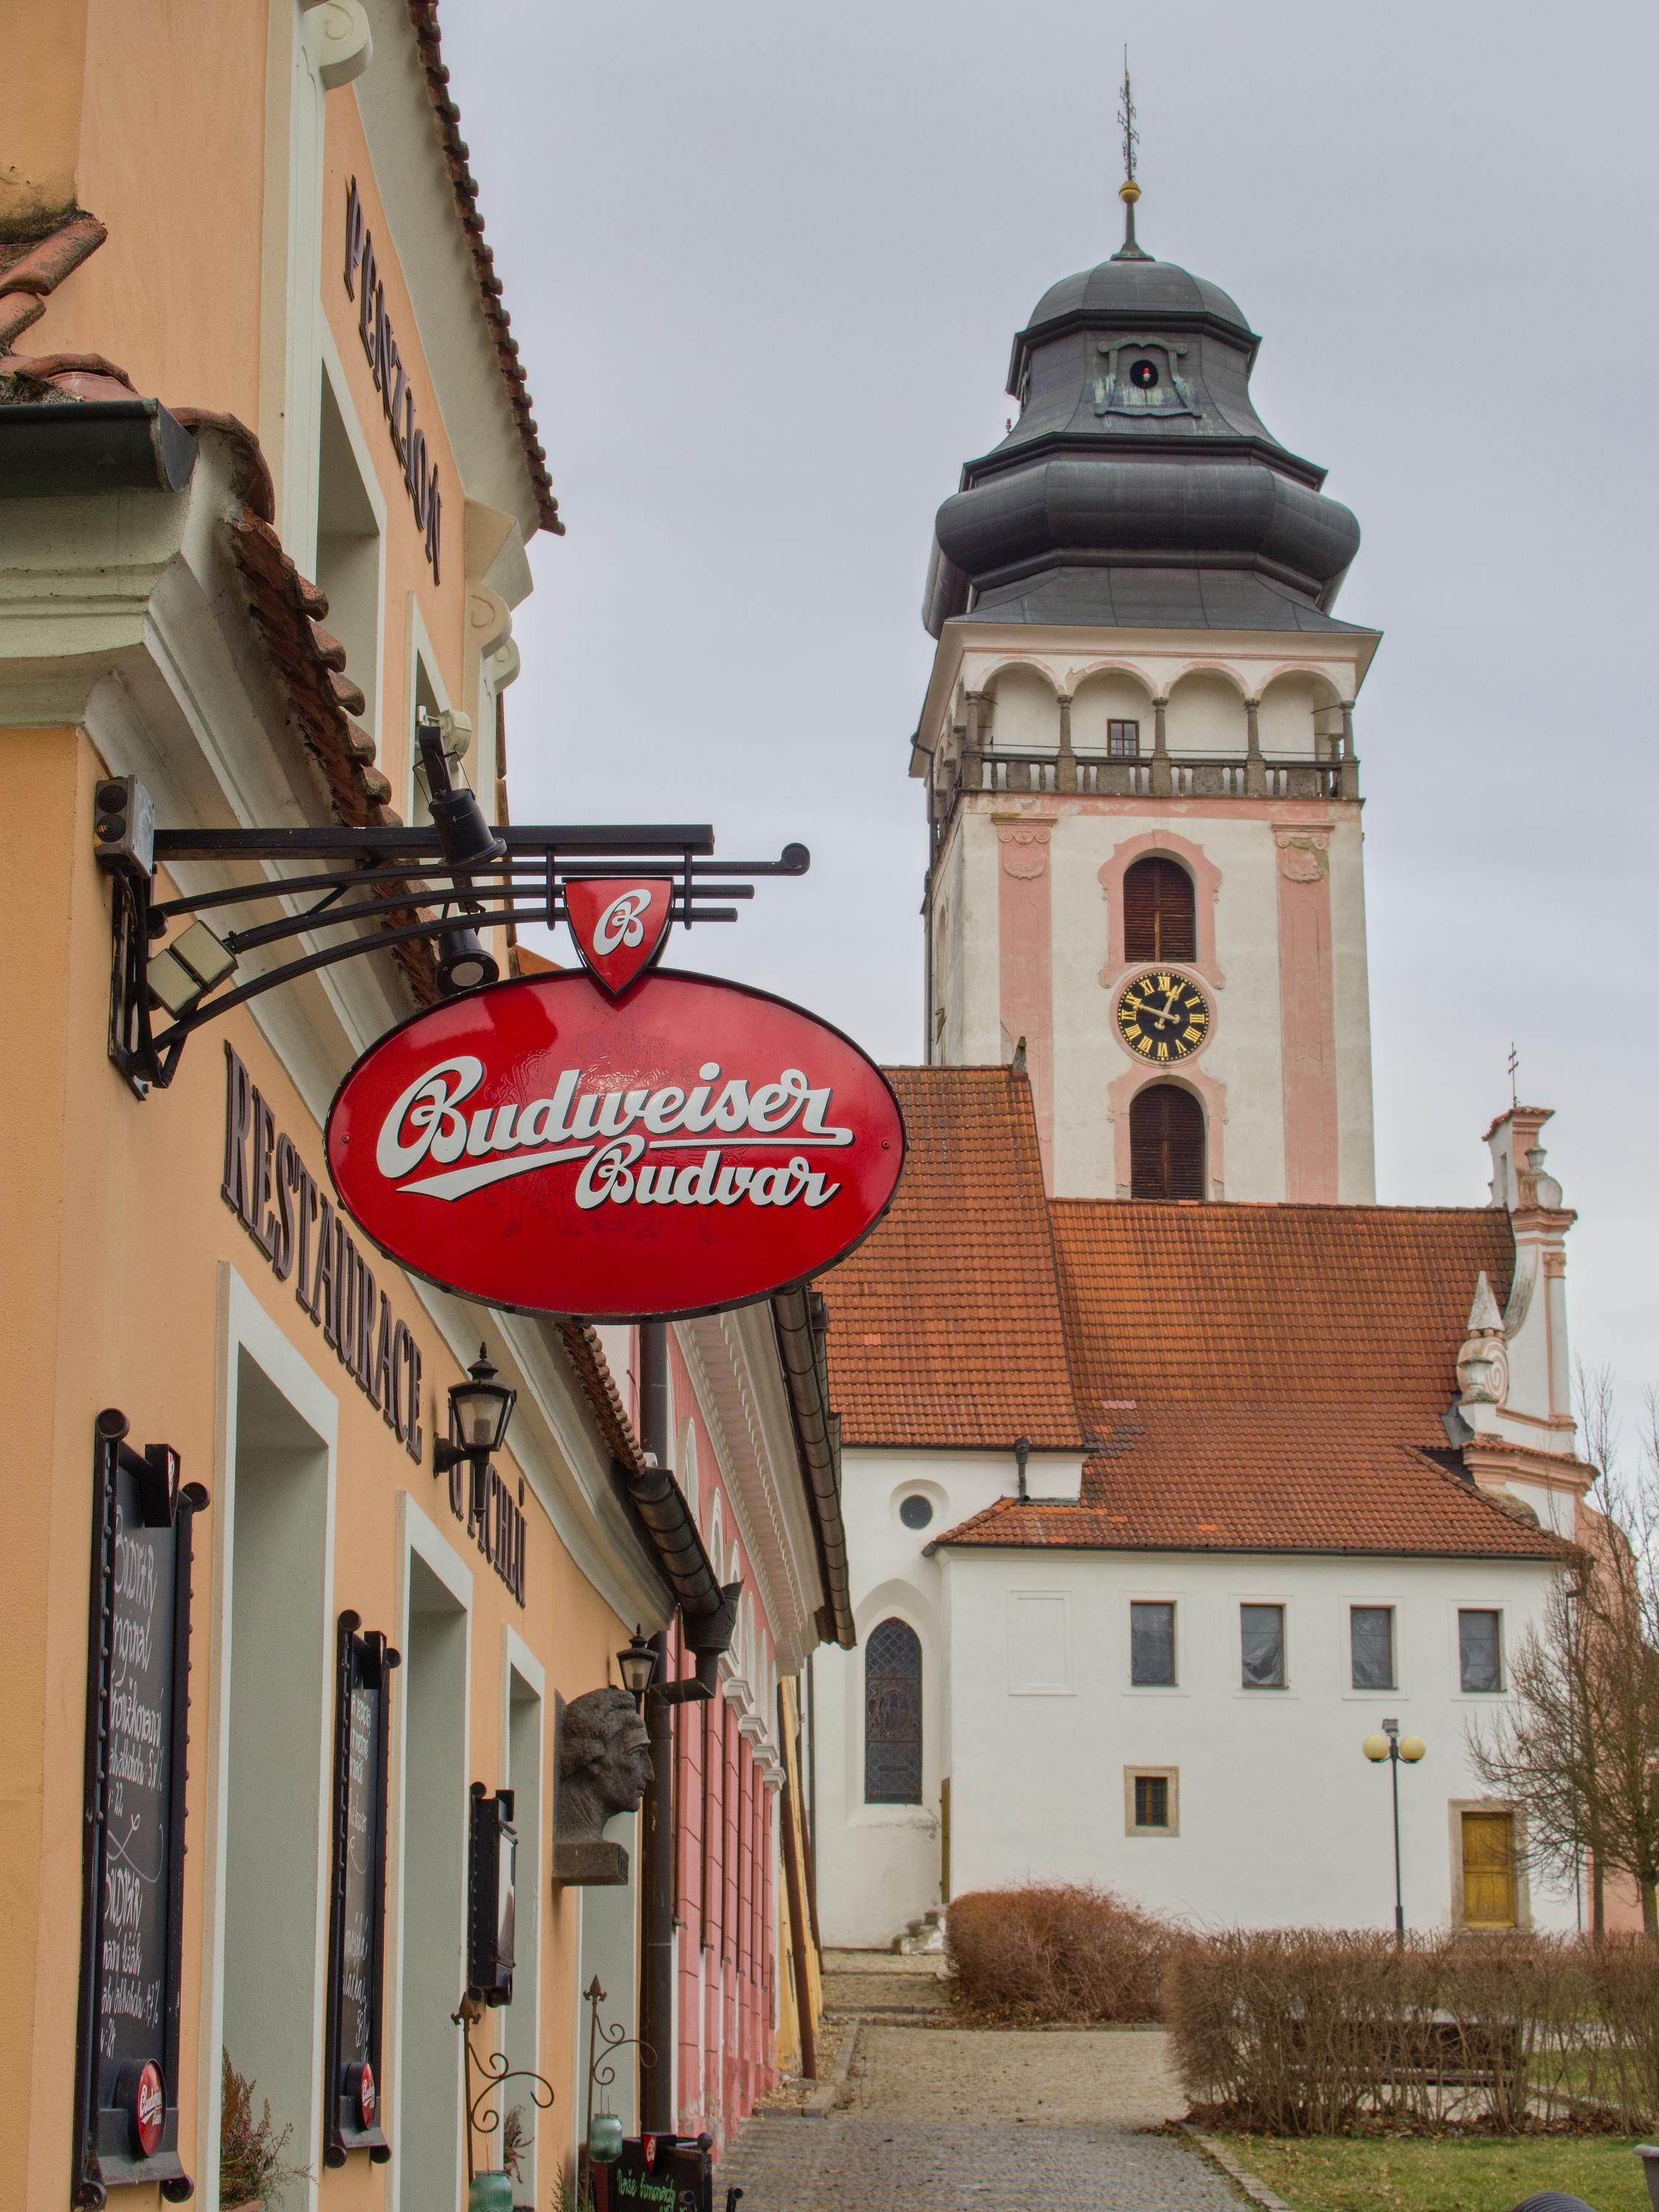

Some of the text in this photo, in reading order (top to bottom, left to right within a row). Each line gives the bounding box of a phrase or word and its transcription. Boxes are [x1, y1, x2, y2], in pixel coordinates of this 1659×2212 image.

[344, 174, 442, 587] PENZION
[593, 888, 653, 956] B
[1139, 978, 1155, 996] XI
[1158, 976, 1171, 991] XII
[1185, 996, 1200, 1008] II
[1190, 1014, 1205, 1024] III
[376, 1055, 855, 1186] Budweiser
[574, 1135, 841, 1209] Budvar
[222, 1038, 423, 1466] RESTAURACE
